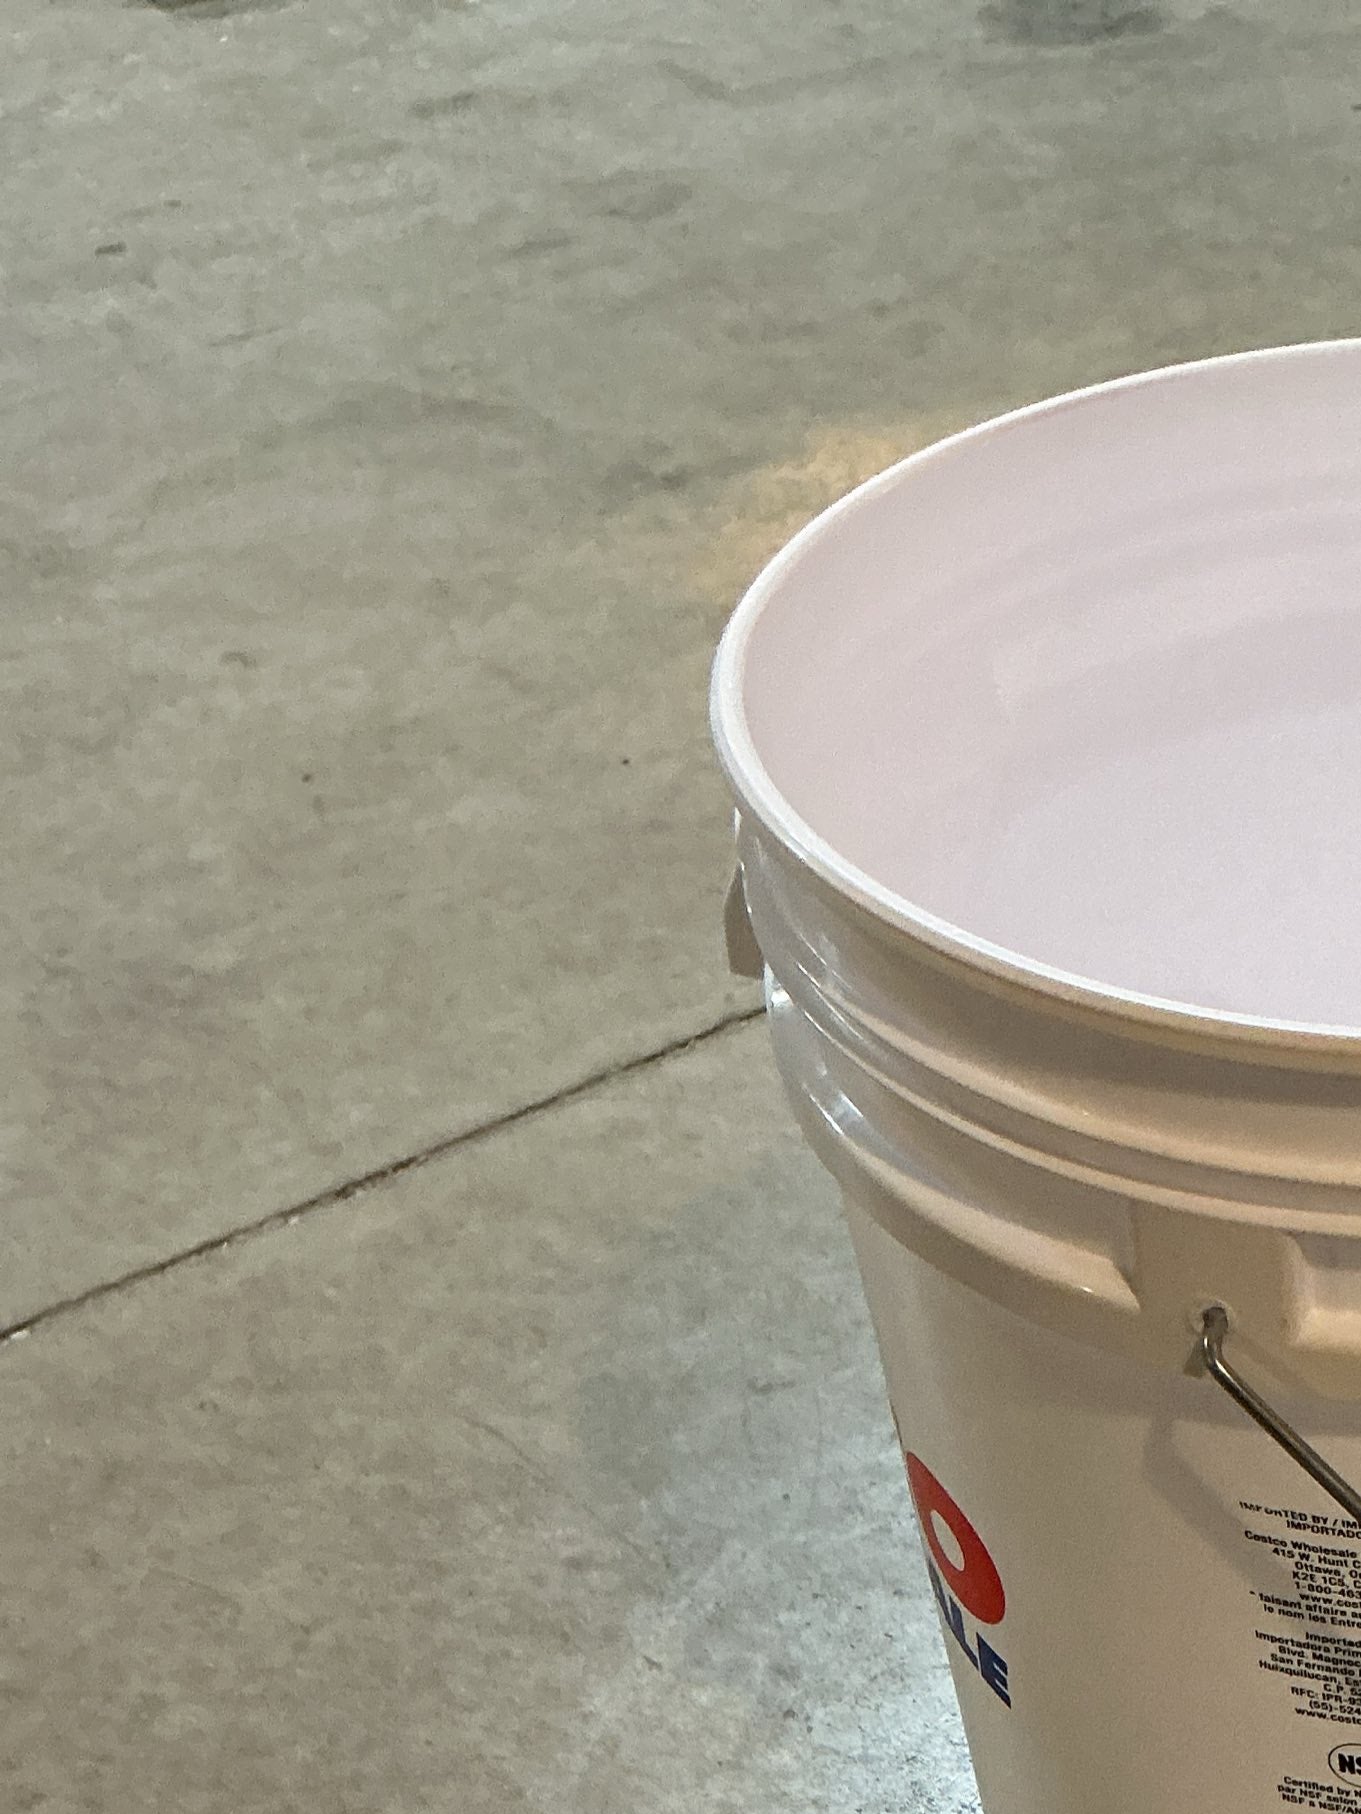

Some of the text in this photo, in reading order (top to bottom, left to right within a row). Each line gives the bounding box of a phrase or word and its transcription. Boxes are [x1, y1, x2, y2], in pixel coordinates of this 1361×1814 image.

[1312, 1516, 1328, 1524] BY
[1245, 1531, 1287, 1547] Costco
[1291, 1541, 1357, 1558] Wholesale
[1272, 1548, 1295, 1558] 415
[1299, 1552, 1314, 1562] W.
[1319, 1555, 1348, 1567] Hunt
[1295, 1562, 1345, 1577] Ottawa,
[1293, 1571, 1317, 1582] K2E
[1322, 1577, 1349, 1588] 1C5,
[1259, 1593, 1302, 1609] faisant
[1306, 1604, 1347, 1616] affaire
[1264, 1604, 1274, 1613] le
[1279, 1608, 1304, 1619] nom
[1309, 1612, 1326, 1623] les
[1256, 1630, 1330, 1653] Importadora
[1279, 1646, 1308, 1658] Blvd.
[1271, 1654, 1294, 1665] San
[1298, 1659, 1354, 1675] Fernando
[1278, 1785, 1296, 1794] par
[1300, 1789, 1323, 1799] NSF
[1327, 1795, 1357, 1805] selon
[1284, 1776, 1334, 1793] Certified
[1338, 1788, 1351, 1798] by
[1282, 1793, 1305, 1803] NSF
